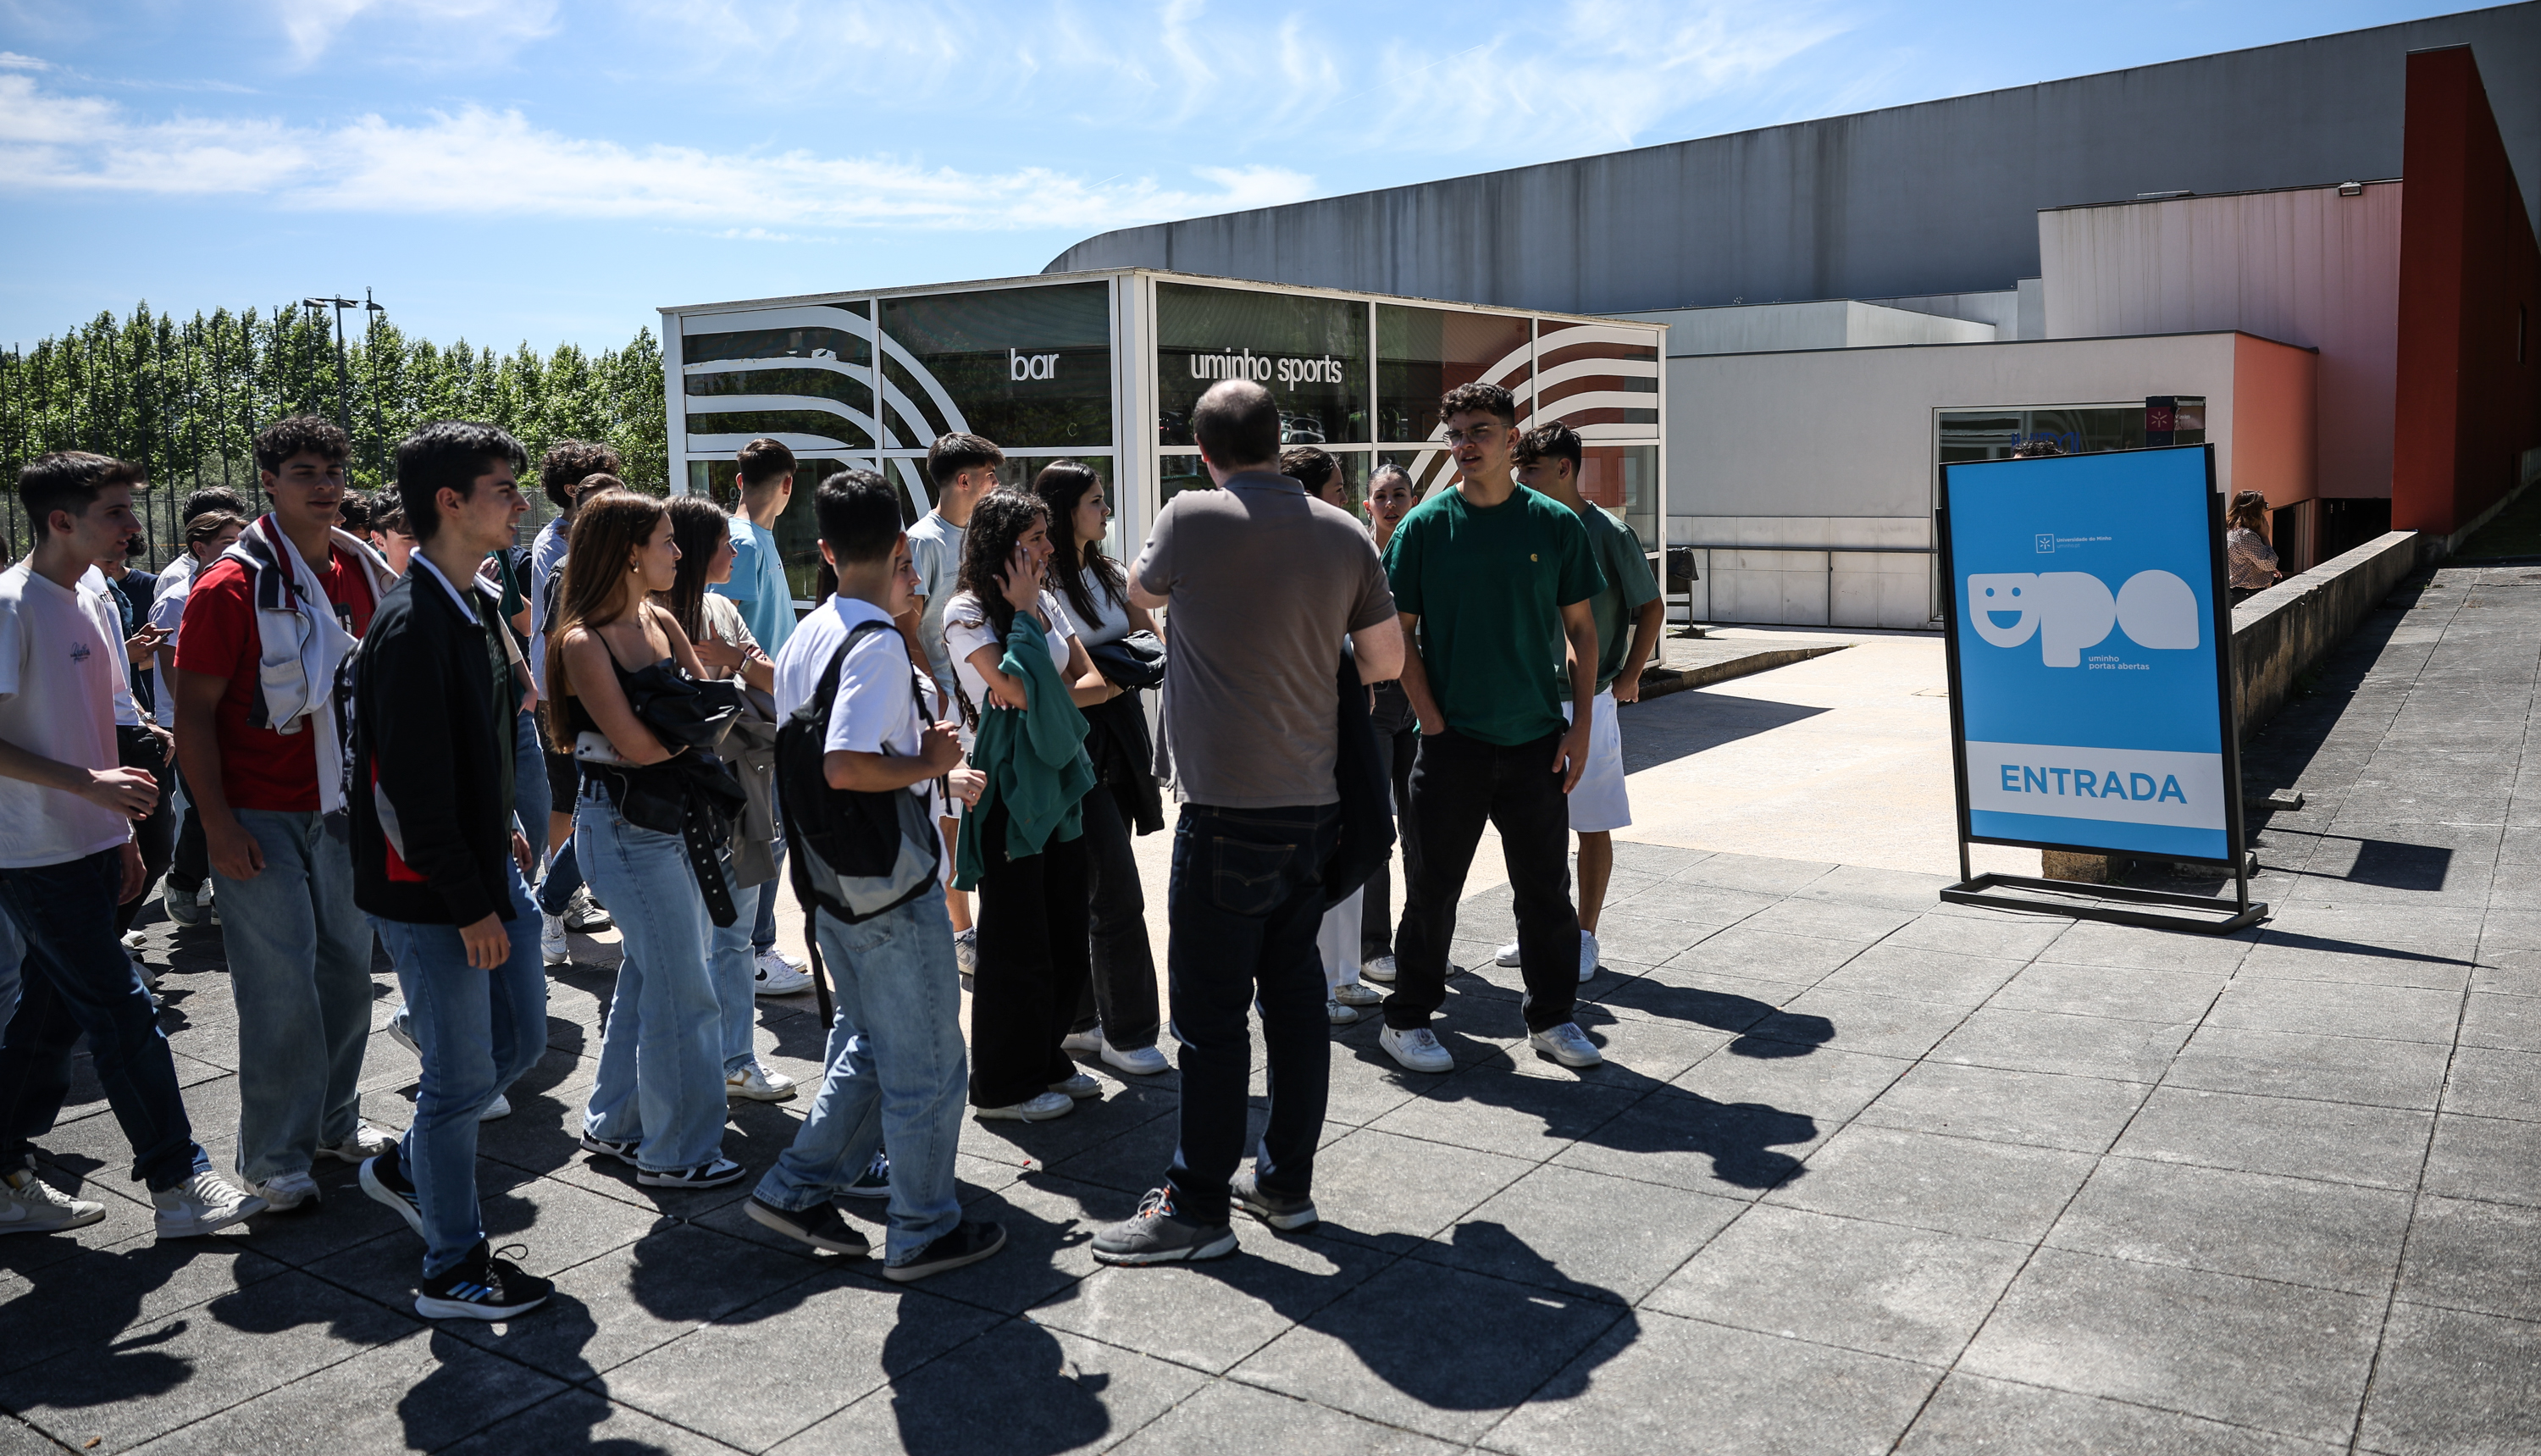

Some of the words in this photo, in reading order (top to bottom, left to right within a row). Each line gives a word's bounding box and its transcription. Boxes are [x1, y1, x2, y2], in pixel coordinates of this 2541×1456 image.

[1010, 347, 1060, 381] bar
[1190, 346, 1271, 381] uminho
[1277, 354, 1342, 391] sports
[1968, 569, 2200, 667] upa
[2089, 662, 2116, 671] portas
[2001, 764, 2188, 805] ENTRADA
